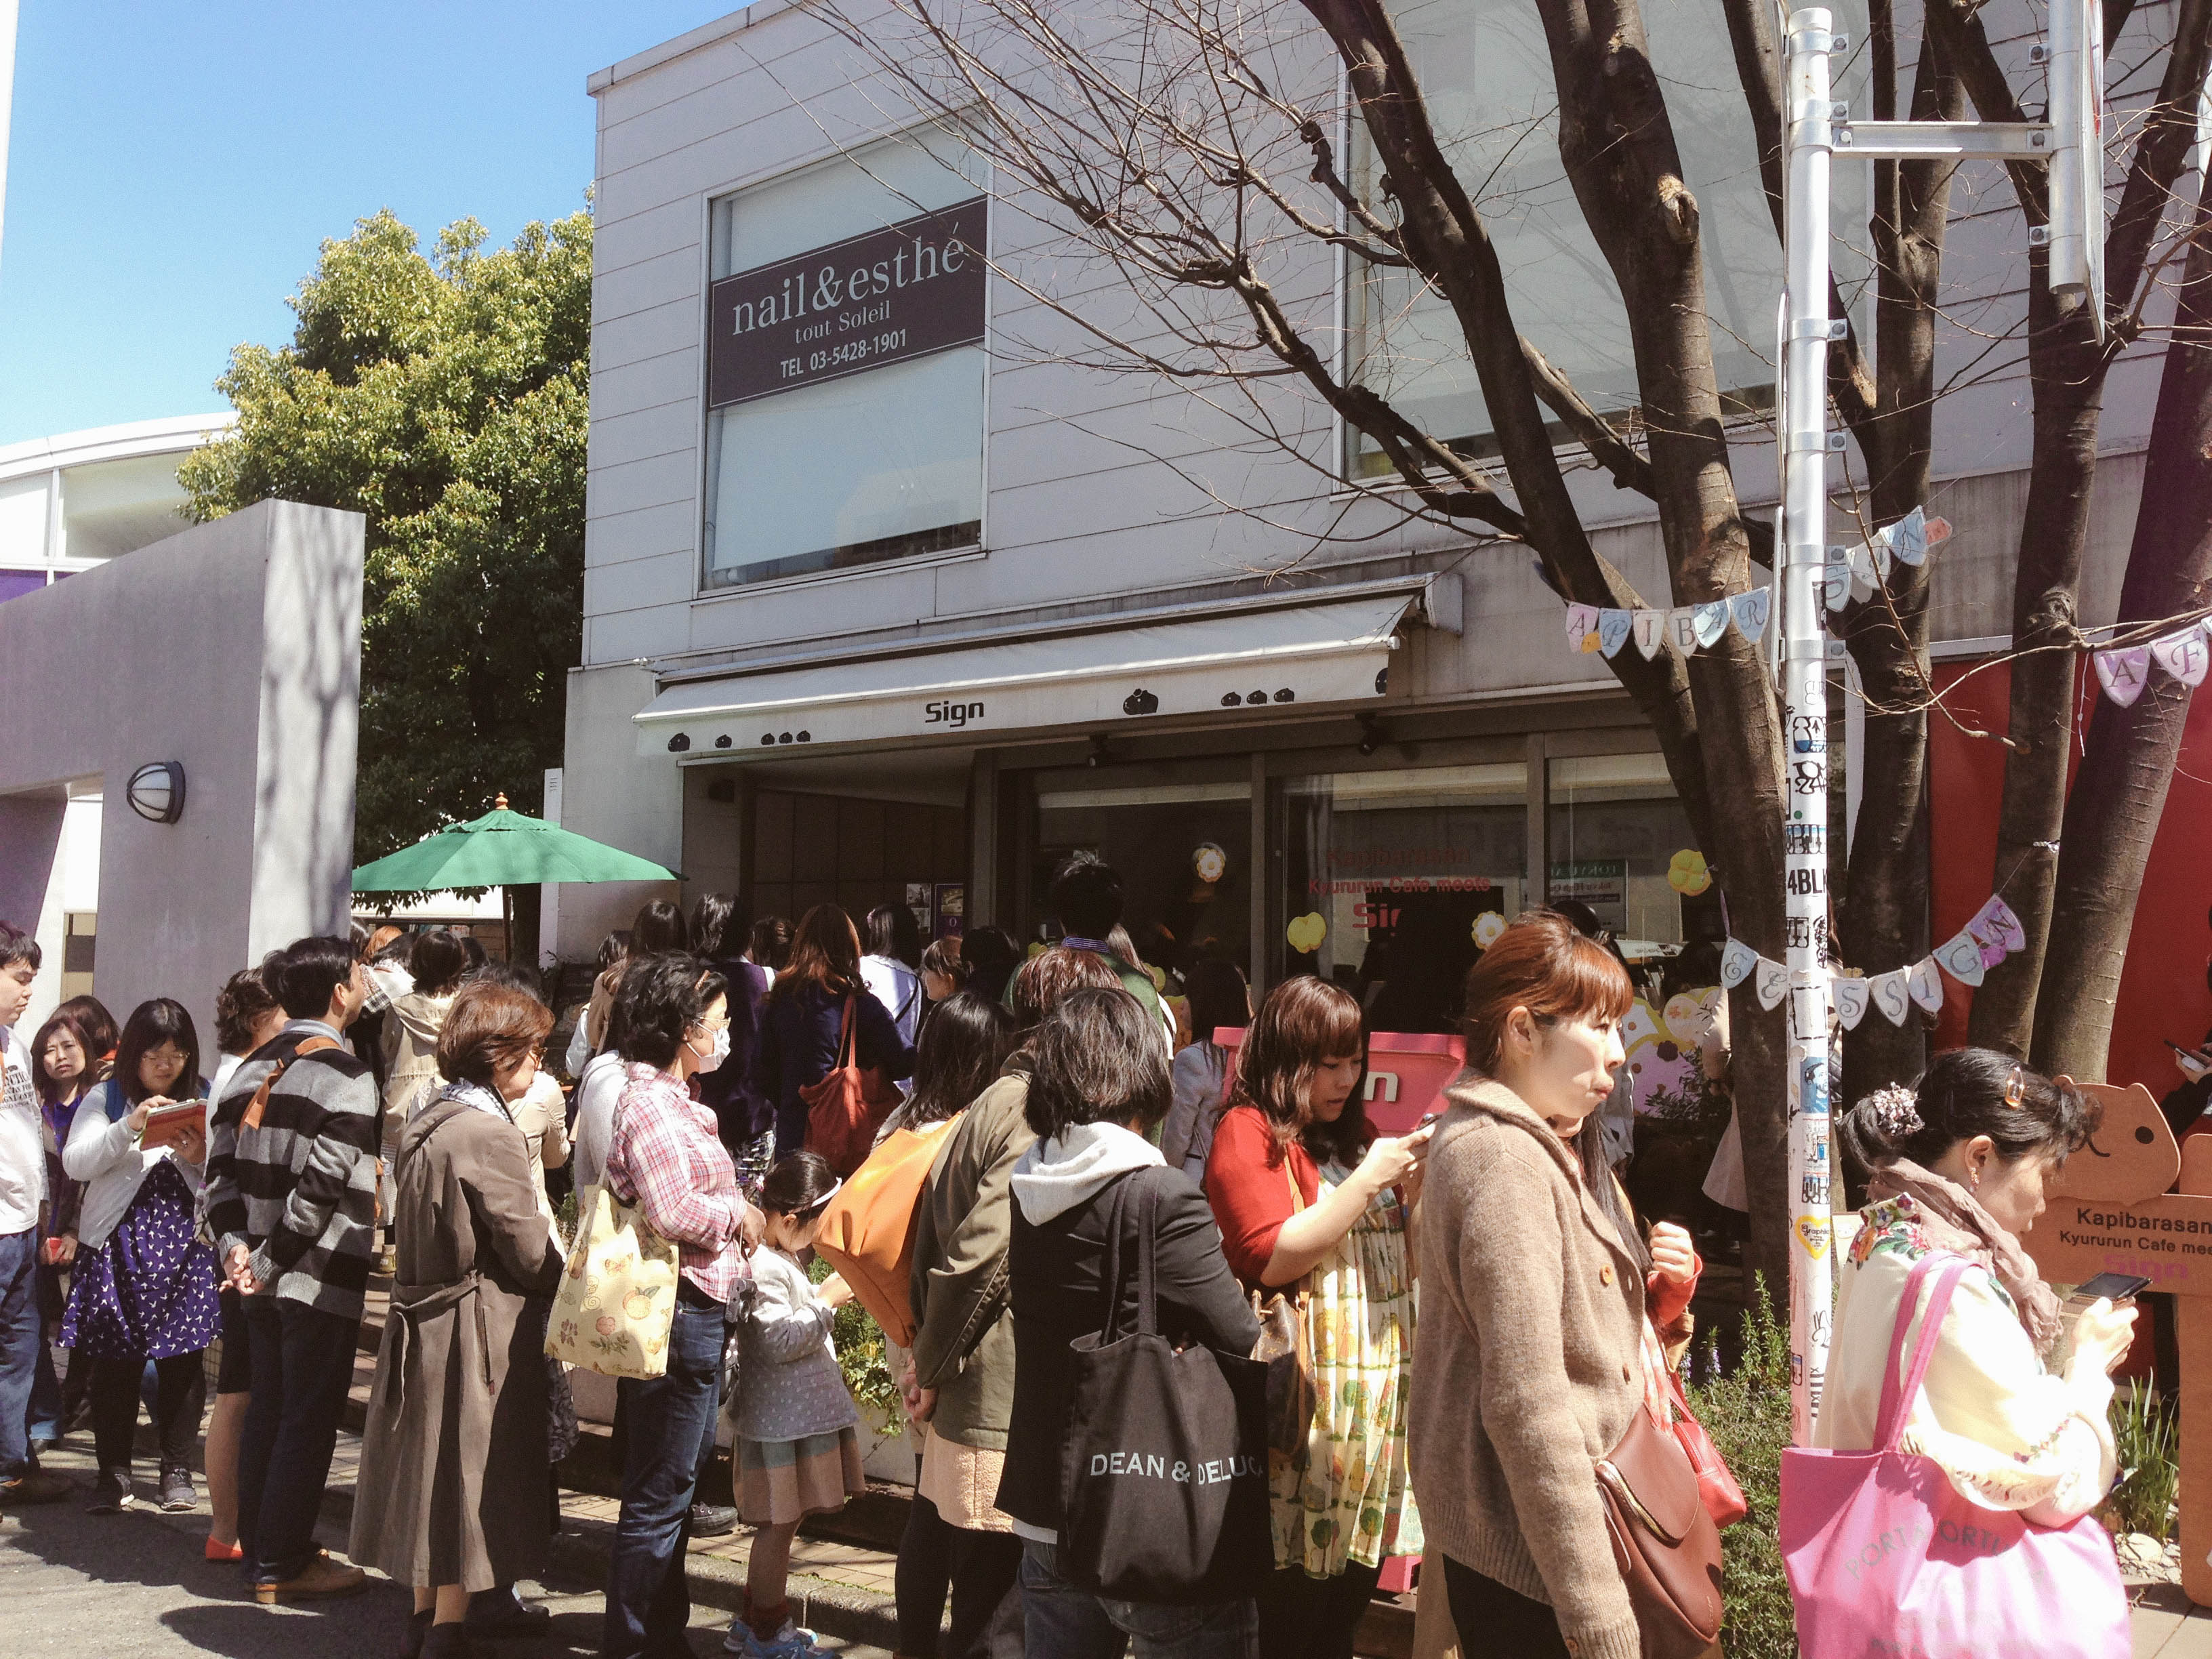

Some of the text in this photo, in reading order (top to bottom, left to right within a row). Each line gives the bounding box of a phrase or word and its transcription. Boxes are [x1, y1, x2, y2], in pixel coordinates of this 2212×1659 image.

[795, 300, 890, 344] tout Soleil
[780, 329, 906, 378] TEL 03-5428-1901
[925, 701, 984, 728] Sign
[1389, 876, 1430, 893] Cafe
[1436, 876, 1490, 892] meets
[1352, 903, 1401, 937] Si
[2076, 1208, 2212, 1235] Kapibarasan
[2060, 1230, 2131, 1248] Kyururun
[2138, 1237, 2175, 1252] Cafe
[1090, 1452, 1164, 1479] DEAN
[1171, 1460, 1191, 1483] &
